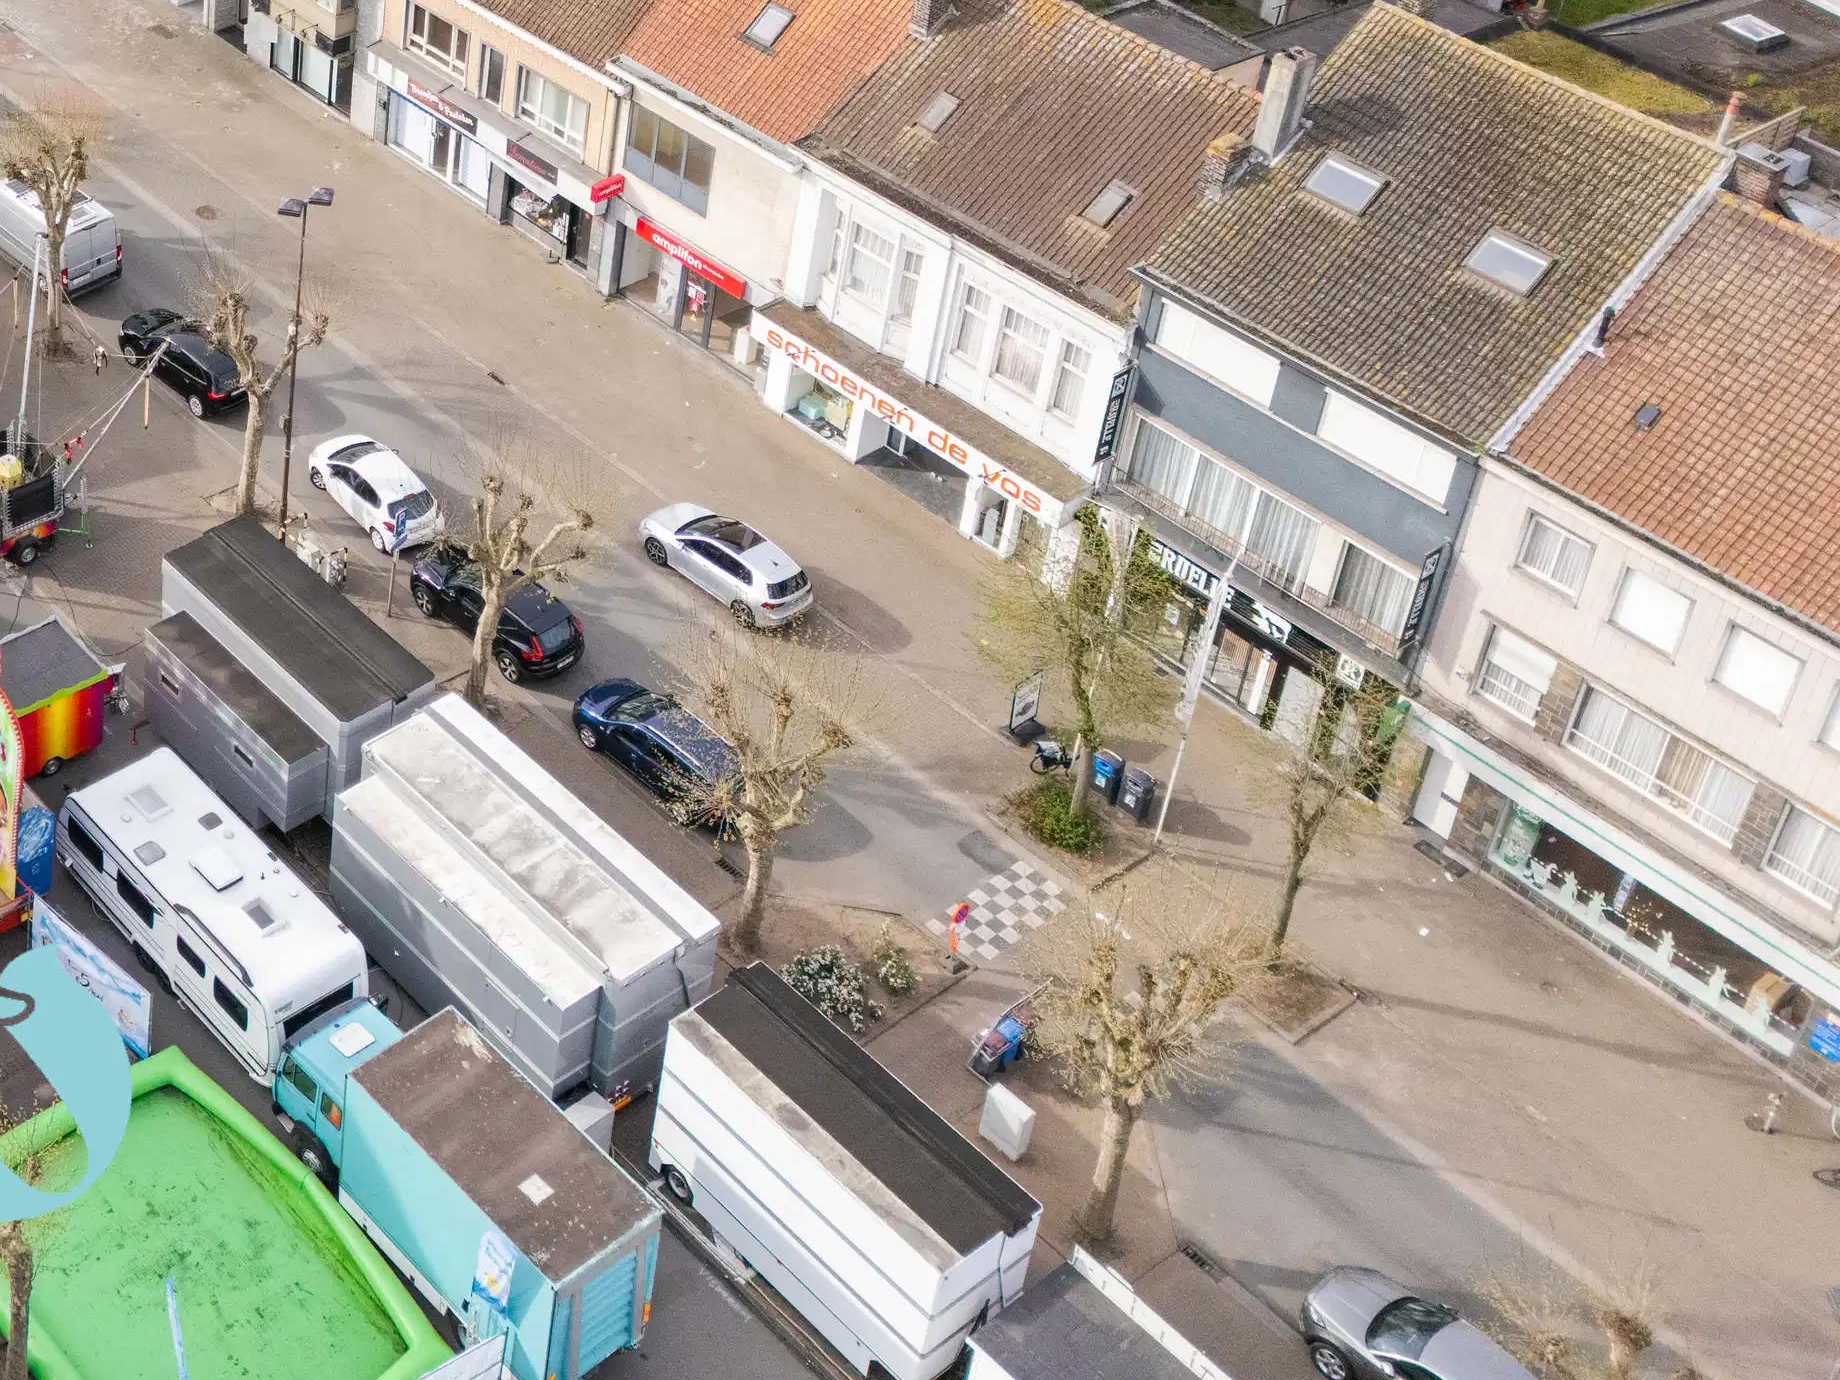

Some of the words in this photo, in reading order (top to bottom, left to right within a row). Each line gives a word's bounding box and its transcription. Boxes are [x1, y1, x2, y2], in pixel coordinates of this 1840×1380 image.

[651, 233, 702, 270] amplifon
[767, 329, 915, 433] schoenen
[927, 429, 968, 466] de
[982, 462, 1041, 513] vos
